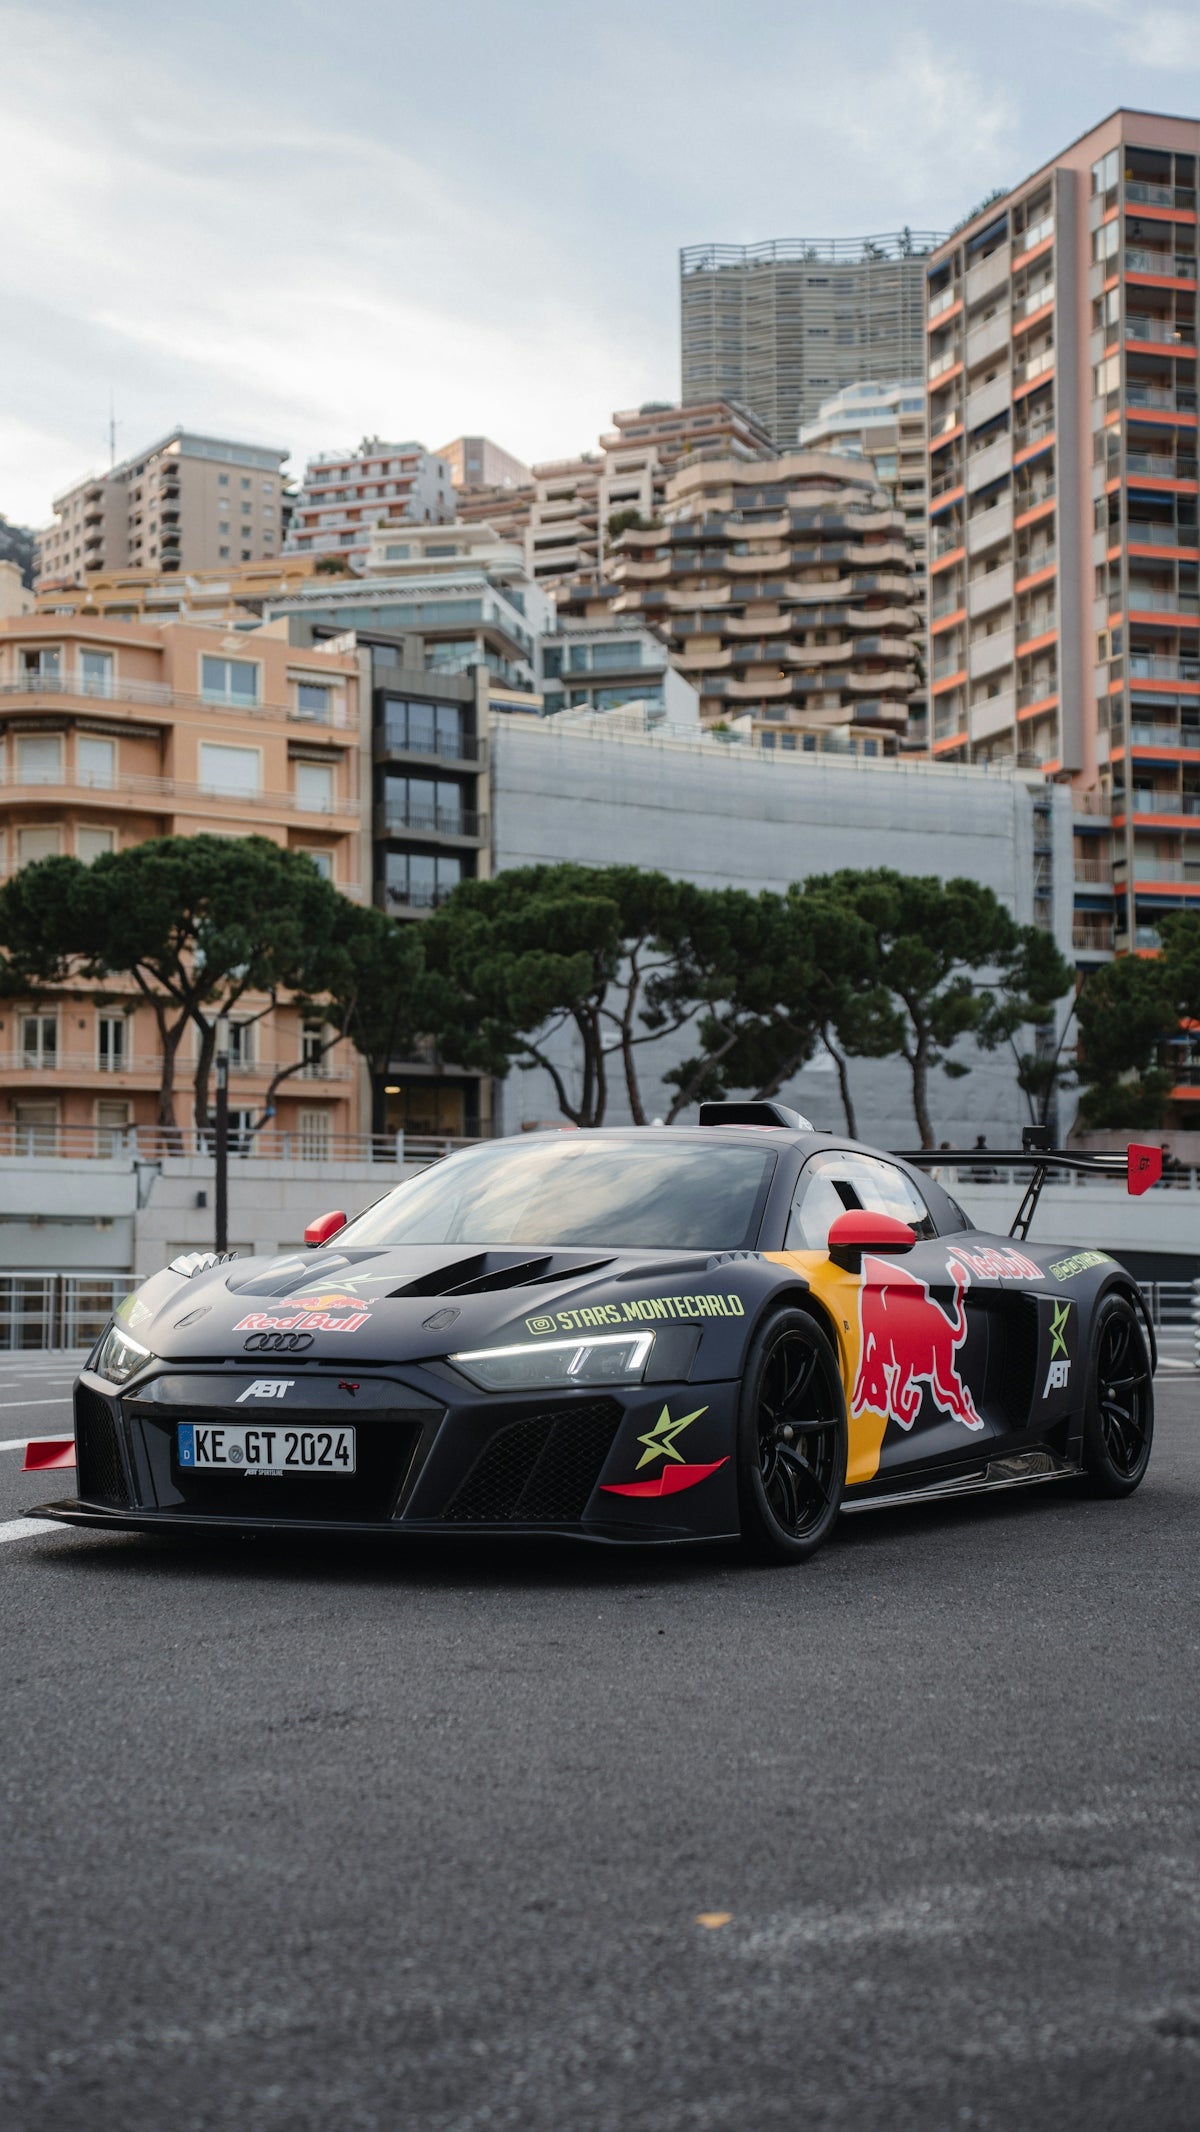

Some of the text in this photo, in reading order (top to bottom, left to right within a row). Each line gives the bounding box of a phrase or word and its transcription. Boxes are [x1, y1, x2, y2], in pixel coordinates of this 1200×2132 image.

[232, 1311, 373, 1333] Red Bull
[556, 1294, 745, 1331] STARS.MONTECARLO
[235, 1379, 296, 1403] ABT
[1042, 1359, 1072, 1399] ABT
[183, 1429, 350, 1466] D KE GT 2024
[243, 1468, 258, 1477] ABT
